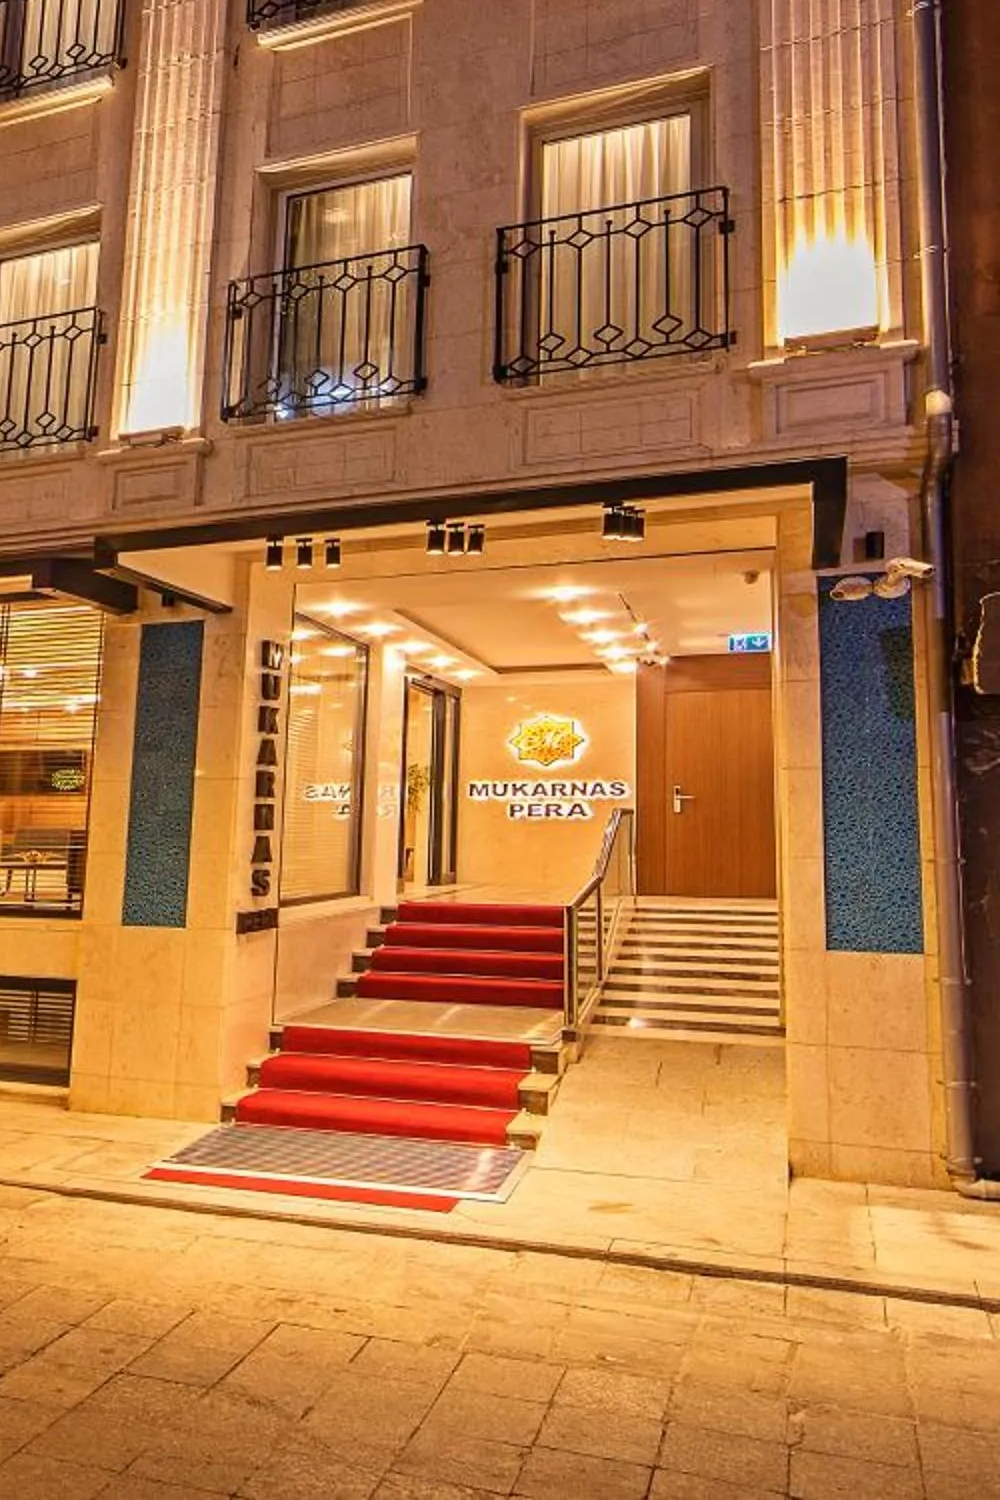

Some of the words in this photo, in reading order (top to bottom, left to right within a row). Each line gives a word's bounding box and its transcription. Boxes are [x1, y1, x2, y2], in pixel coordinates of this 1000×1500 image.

[250, 640, 283, 897] MUKARNAS
[468, 782, 626, 797] MUKARNAS
[509, 803, 589, 818] PERA
